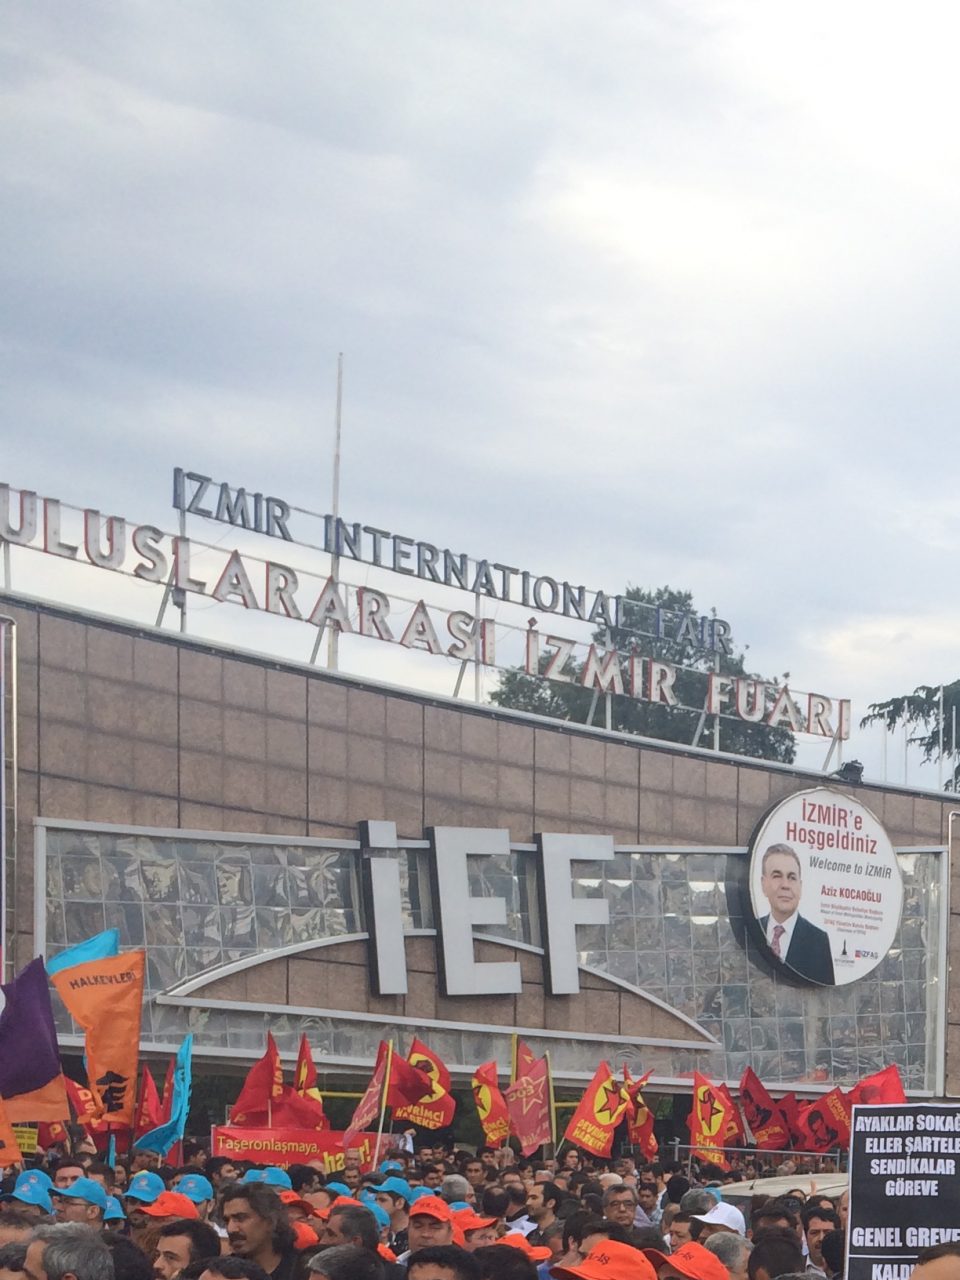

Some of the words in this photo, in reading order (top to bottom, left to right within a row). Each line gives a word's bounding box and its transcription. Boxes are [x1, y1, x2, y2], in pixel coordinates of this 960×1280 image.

[173, 467, 293, 542] IZMIR
[324, 514, 624, 630] INTERNATIONAL
[655, 608, 734, 656] FAIR
[0, 483, 496, 666] ULUSLARARASI
[524, 616, 677, 706] İZMİR
[706, 672, 852, 741] FUARI
[786, 821, 877, 855] Hoşgeldiniz
[809, 856, 852, 873] Welcome
[854, 864, 863, 876] to
[821, 885, 838, 897] Aziz
[839, 887, 882, 903] KOCAOĞLU
[855, 1116, 914, 1132] AYAKLAR
[217, 1136, 320, 1156] Taşeronlaşmaya,
[865, 1137, 902, 1153] ELLER
[870, 1156, 956, 1175] SENDİKALAR
[885, 1178, 939, 1196] GÖREVE
[852, 1227, 903, 1247] GENEL
